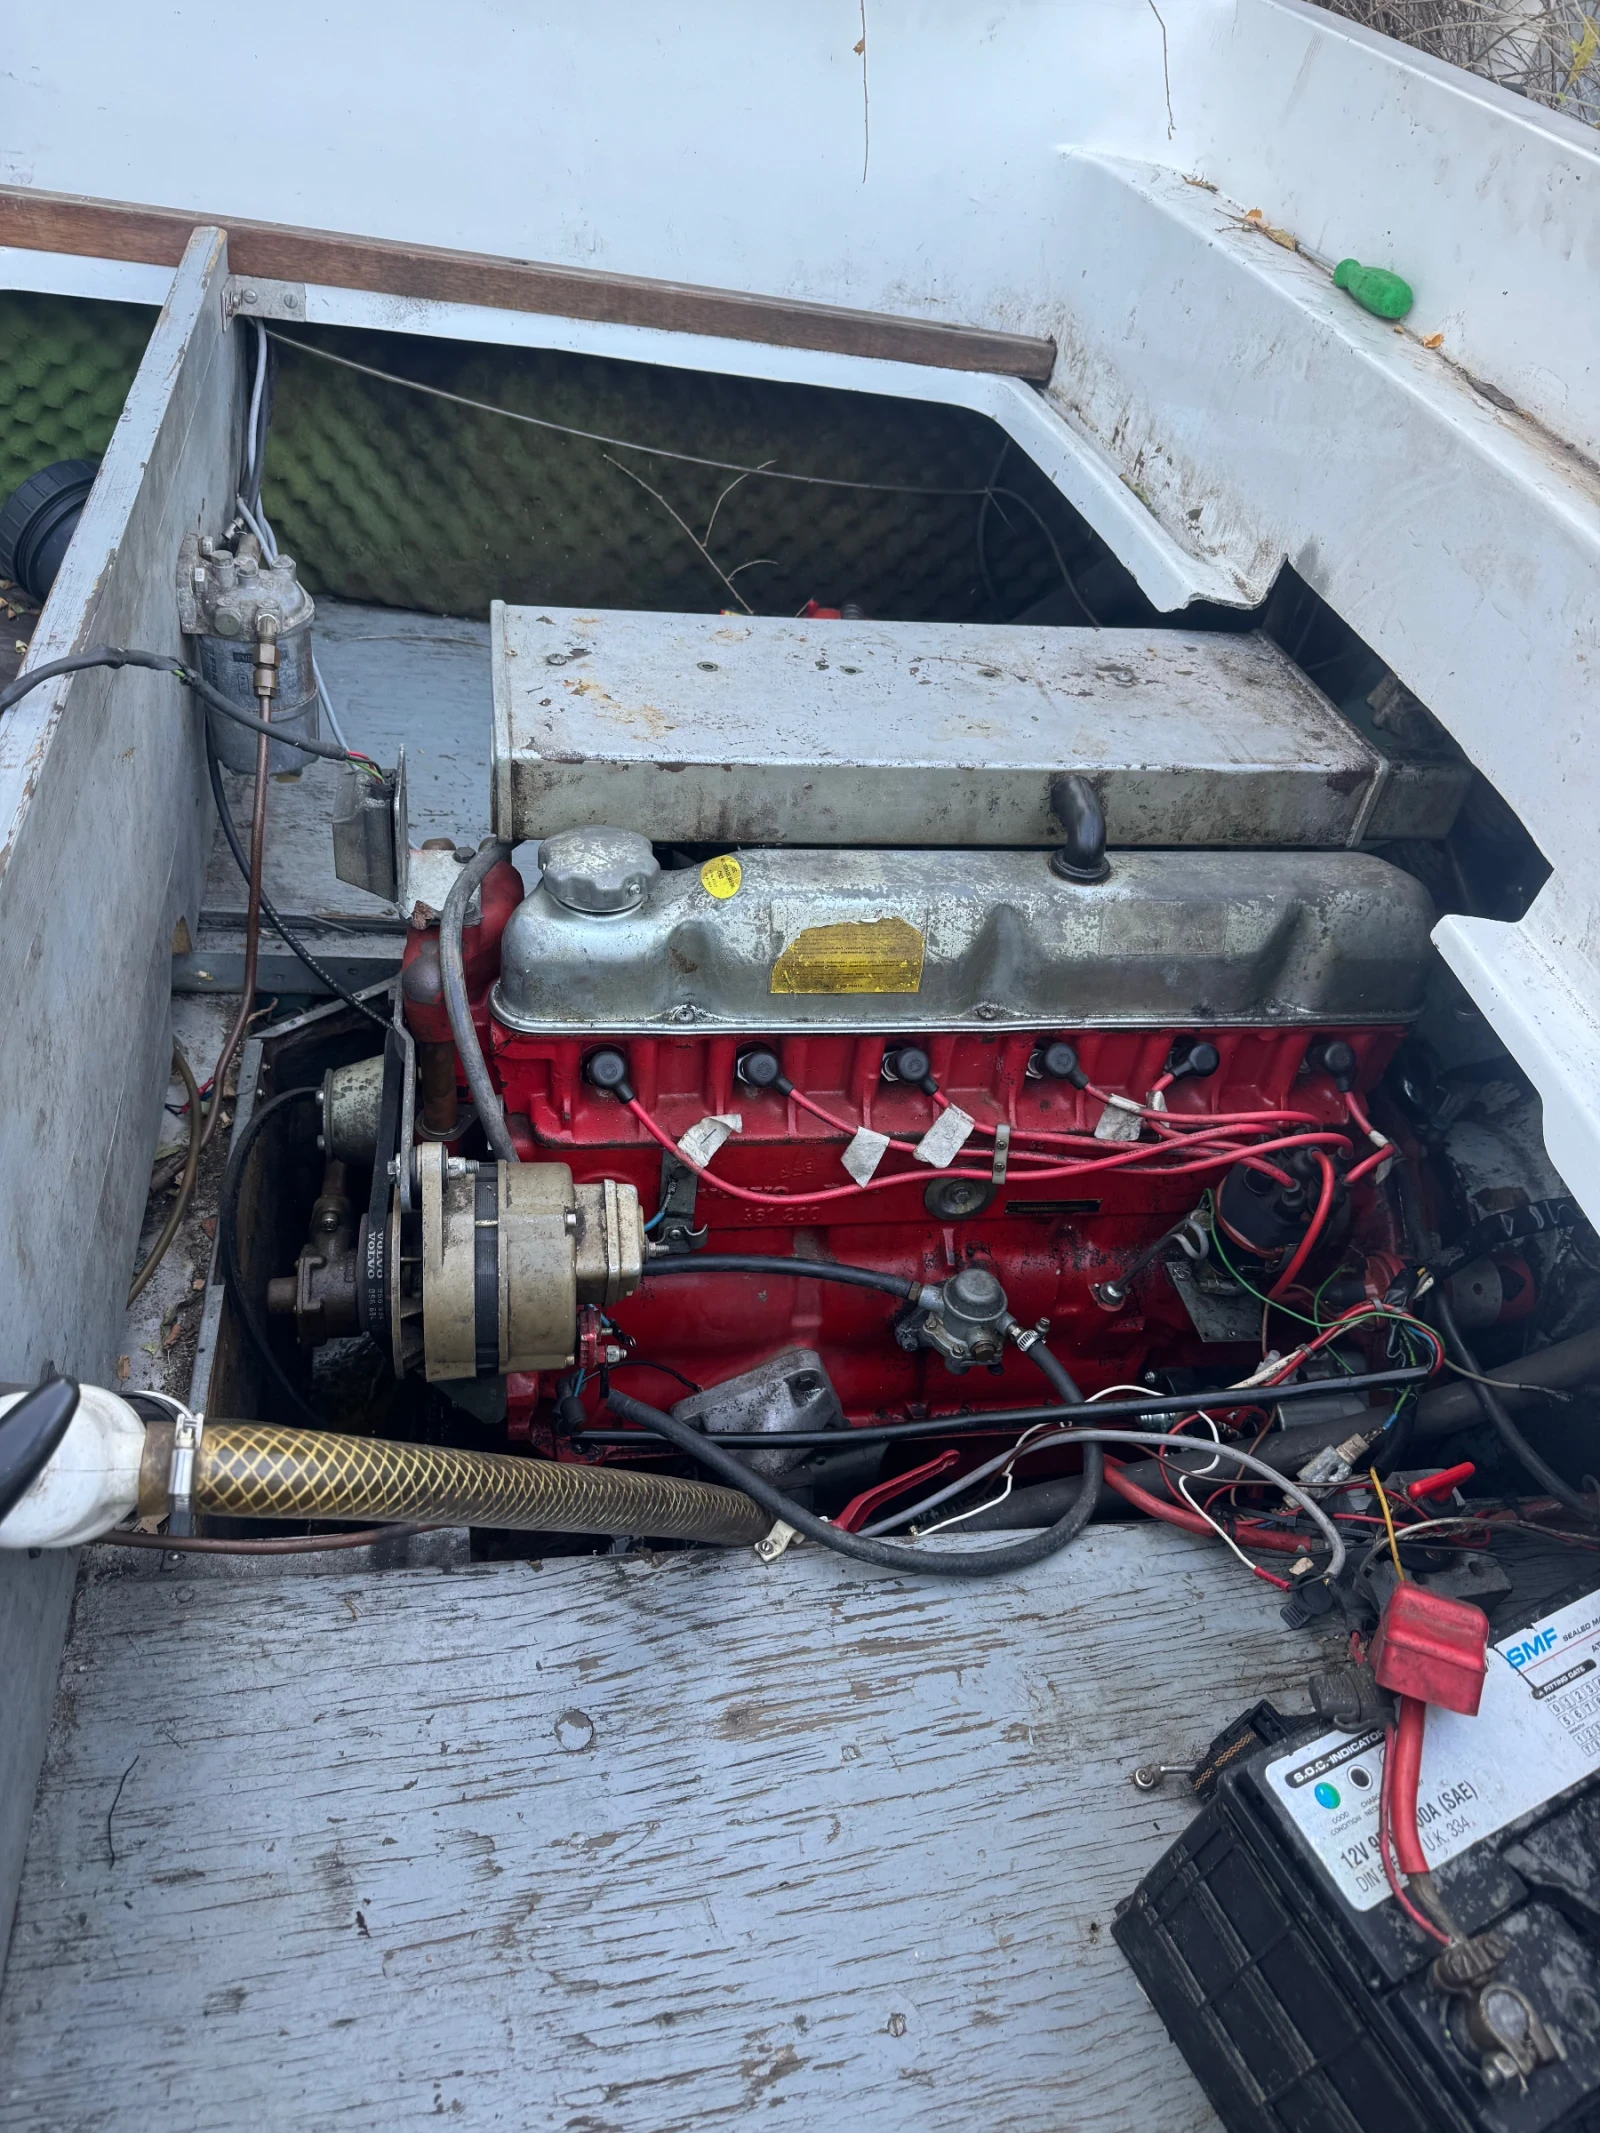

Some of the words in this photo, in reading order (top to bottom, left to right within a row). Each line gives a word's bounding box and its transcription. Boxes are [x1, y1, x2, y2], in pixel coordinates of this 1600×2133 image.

[367, 1231, 376, 1279] VOLVO
[376, 1231, 384, 1279] VOLVO
[1506, 1626, 1558, 1669] SMF
[1562, 1622, 1591, 1642] SEALED
[1543, 1674, 1568, 1693] FITTING
[1567, 1665, 1586, 1679] DATE
[1552, 1704, 1560, 1713] 0
[1564, 1698, 1572, 1707] 1
[1575, 1691, 1583, 1700] 2
[1586, 1684, 1594, 1693] 3
[1563, 1716, 1571, 1725] 5
[1574, 1710, 1582, 1718] 6
[1585, 1703, 1592, 1712] 7
[1577, 1735, 1583, 1743] 1
[1330, 1815, 1362, 1836] CONDITION
[1332, 1811, 1350, 1824] GOOD
[1341, 1842, 1369, 1869] 12V
[1438, 1780, 1479, 1814] (SAE)
[1356, 1868, 1380, 1893] DIN
[1446, 1815, 1471, 1837] 334
